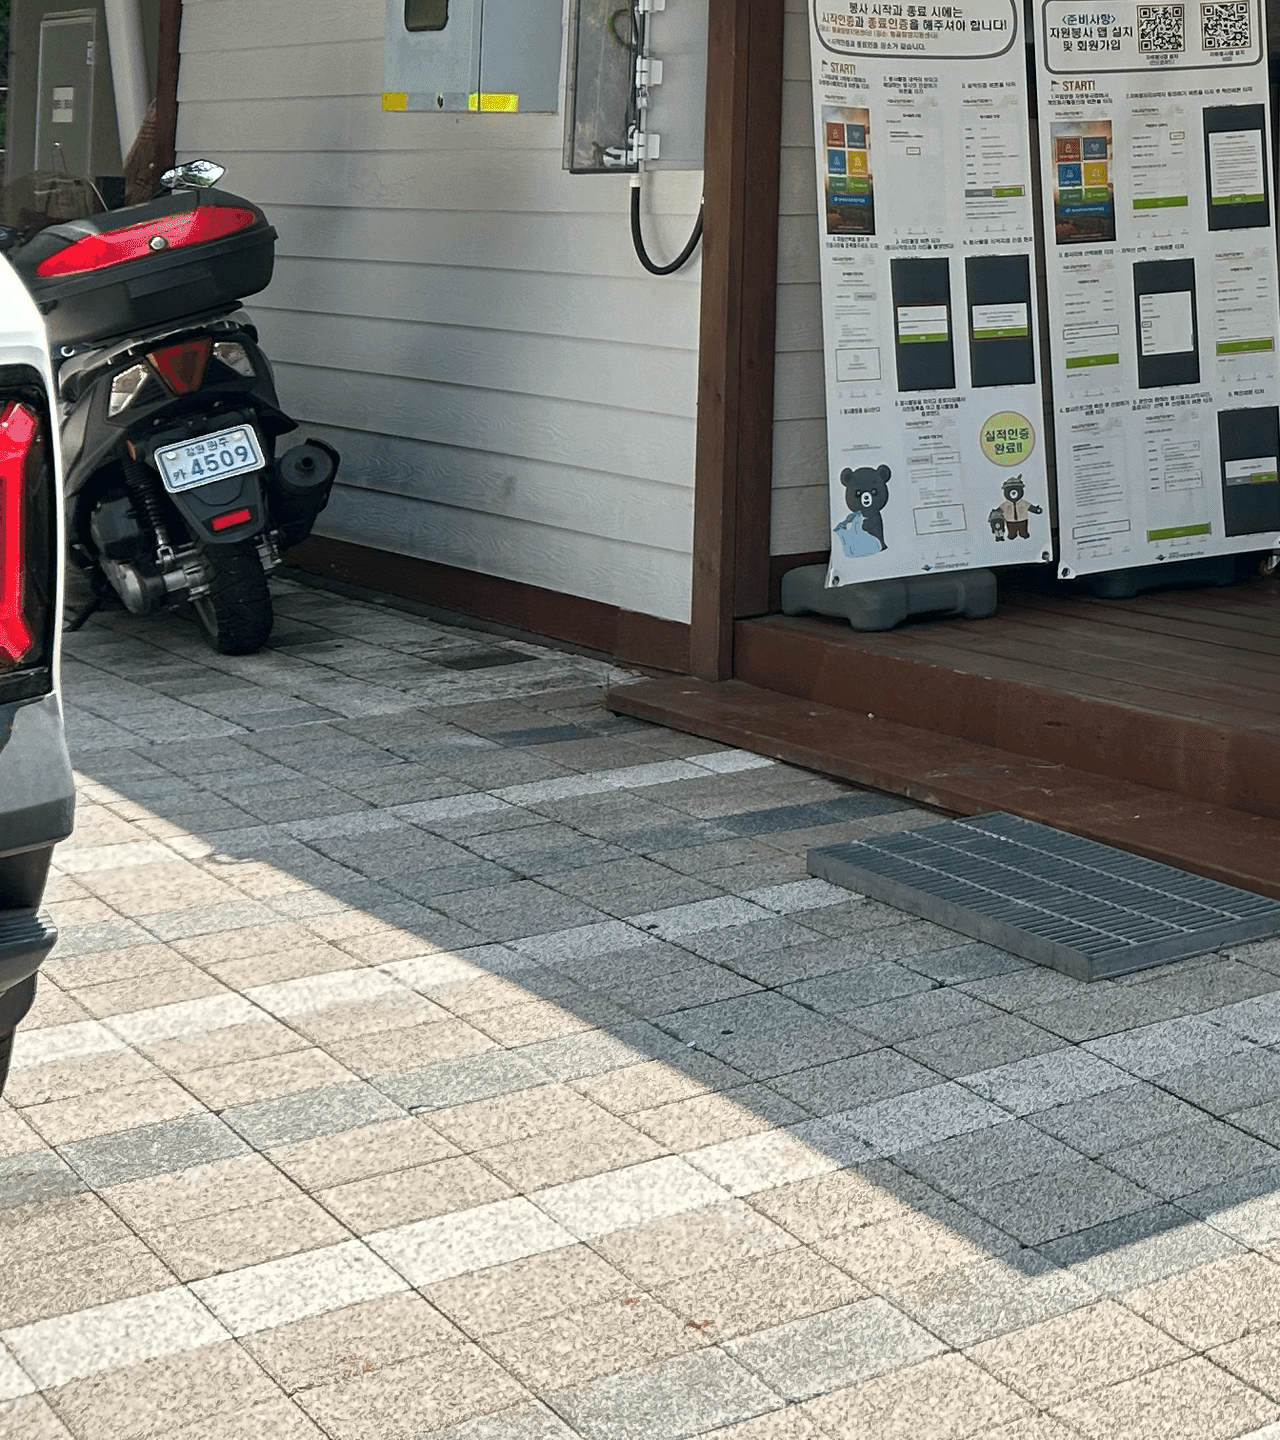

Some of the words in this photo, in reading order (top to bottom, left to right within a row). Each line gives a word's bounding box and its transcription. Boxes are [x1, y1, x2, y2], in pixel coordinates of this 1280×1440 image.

[872, 3, 903, 17] 시작과
[930, 6, 964, 18] 시에는
[1049, 27, 1093, 39] 자원봉사
[1112, 25, 1133, 38] 설치
[1077, 39, 1121, 51] 회원가입
[984, 427, 1030, 443] 실적인증
[190, 445, 248, 476] 4509
